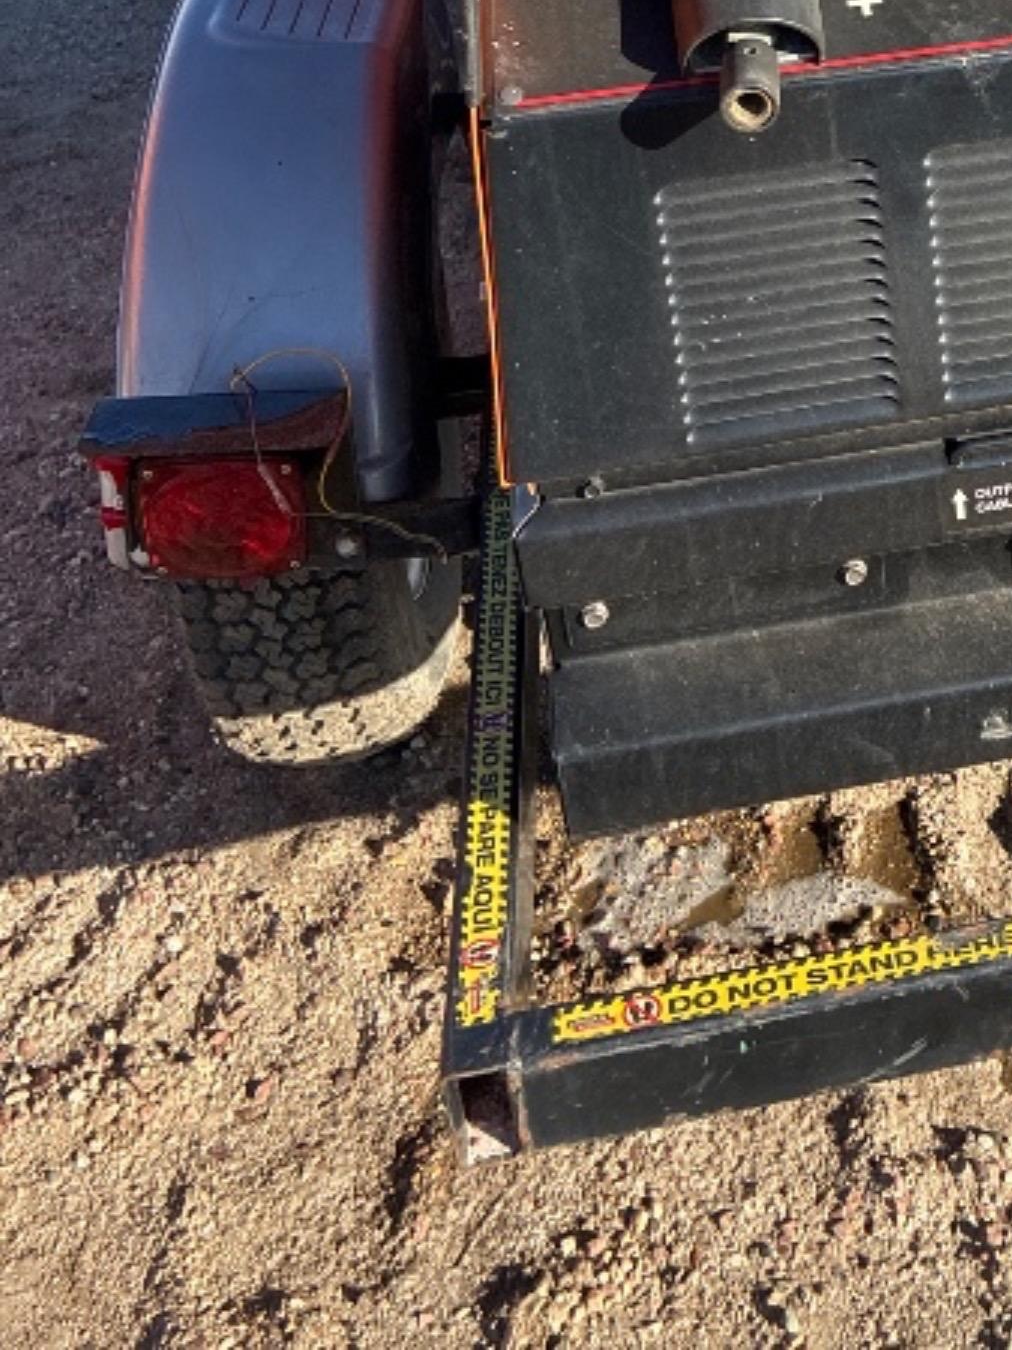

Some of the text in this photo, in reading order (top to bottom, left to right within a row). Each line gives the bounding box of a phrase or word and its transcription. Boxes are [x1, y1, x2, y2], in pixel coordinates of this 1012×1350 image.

[475, 807, 498, 868] PARE
[668, 990, 718, 1014] DO
[728, 975, 793, 1001] NOT
[806, 950, 918, 985] STAND
